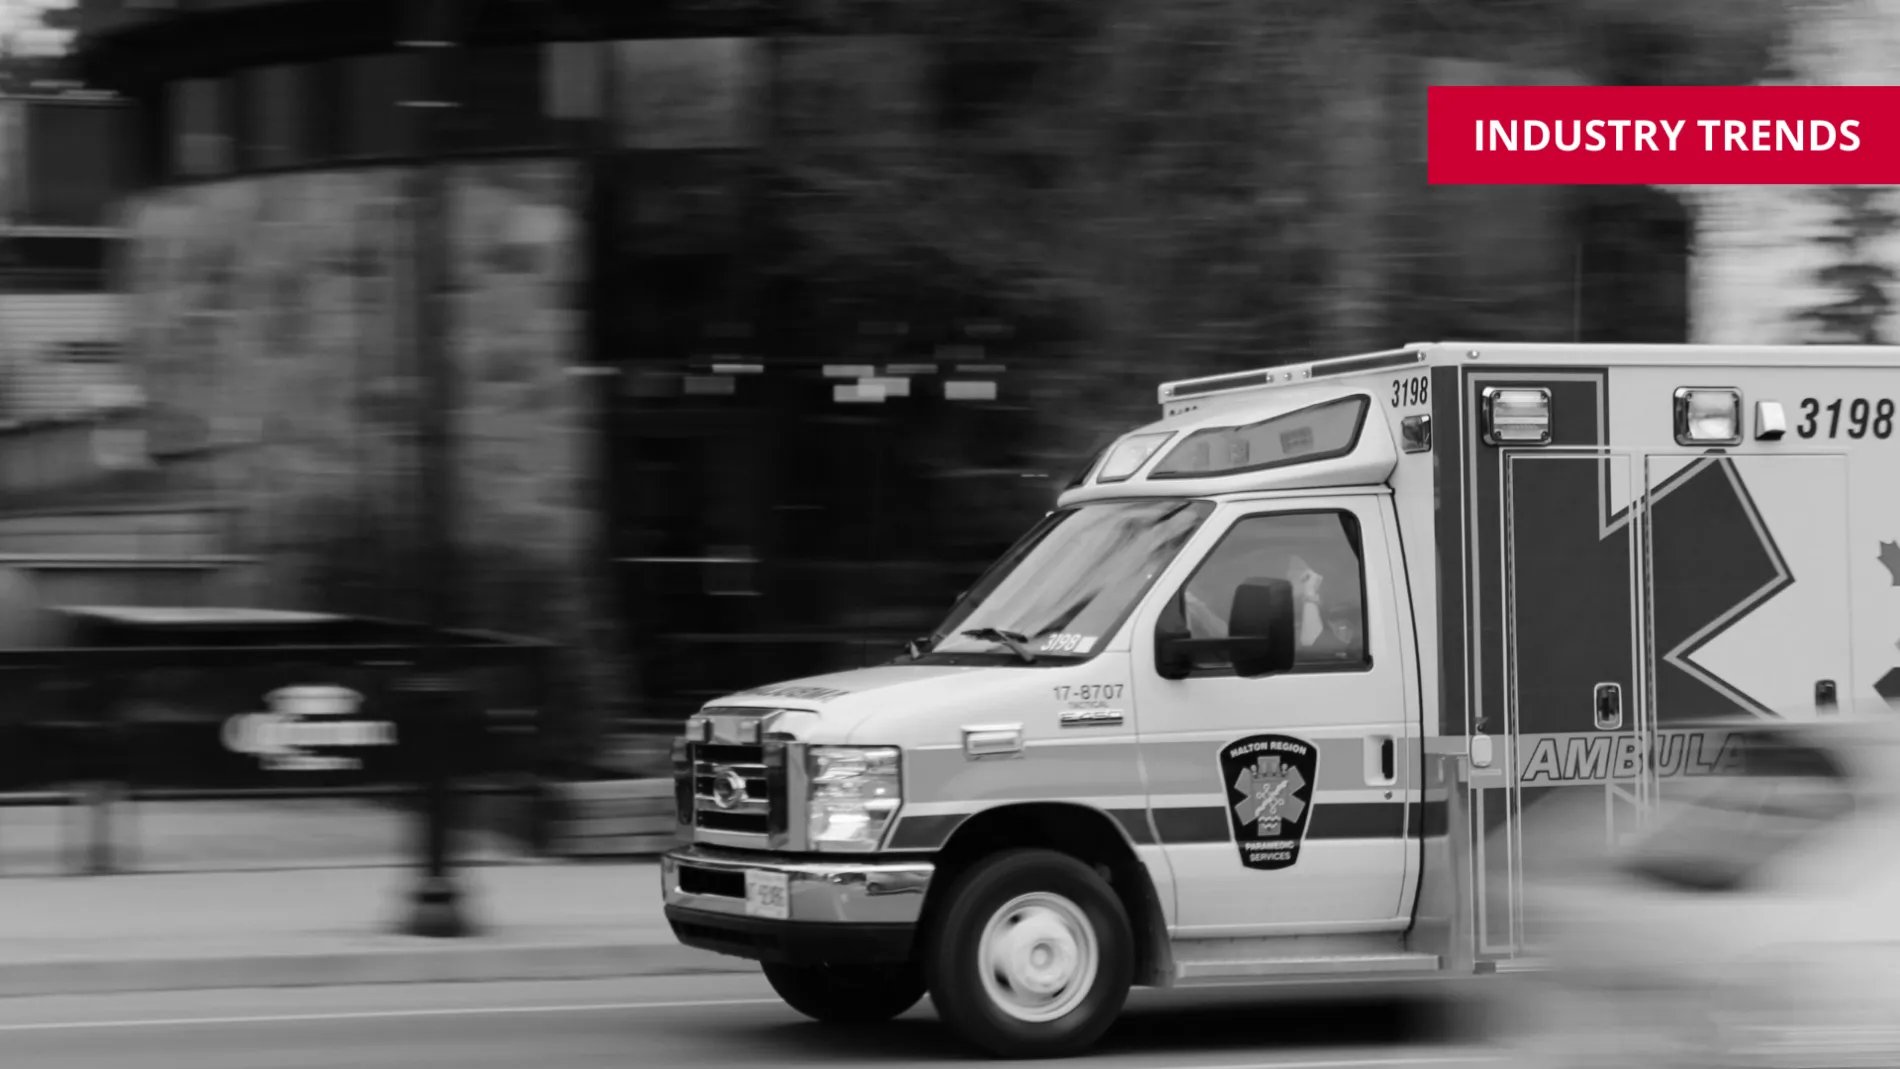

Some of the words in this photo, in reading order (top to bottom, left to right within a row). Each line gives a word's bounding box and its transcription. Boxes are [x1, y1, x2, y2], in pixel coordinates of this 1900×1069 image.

[1391, 376, 1429, 408] 3198
[1797, 397, 1895, 440] 3198
[1040, 633, 1082, 652] 3198
[1053, 684, 1124, 701] 17-8707
[1270, 741, 1307, 756] REGION
[1521, 733, 1747, 781] AMBULA
[1245, 840, 1295, 851] PARAMEDIC
[1249, 851, 1291, 862] SERVICES
